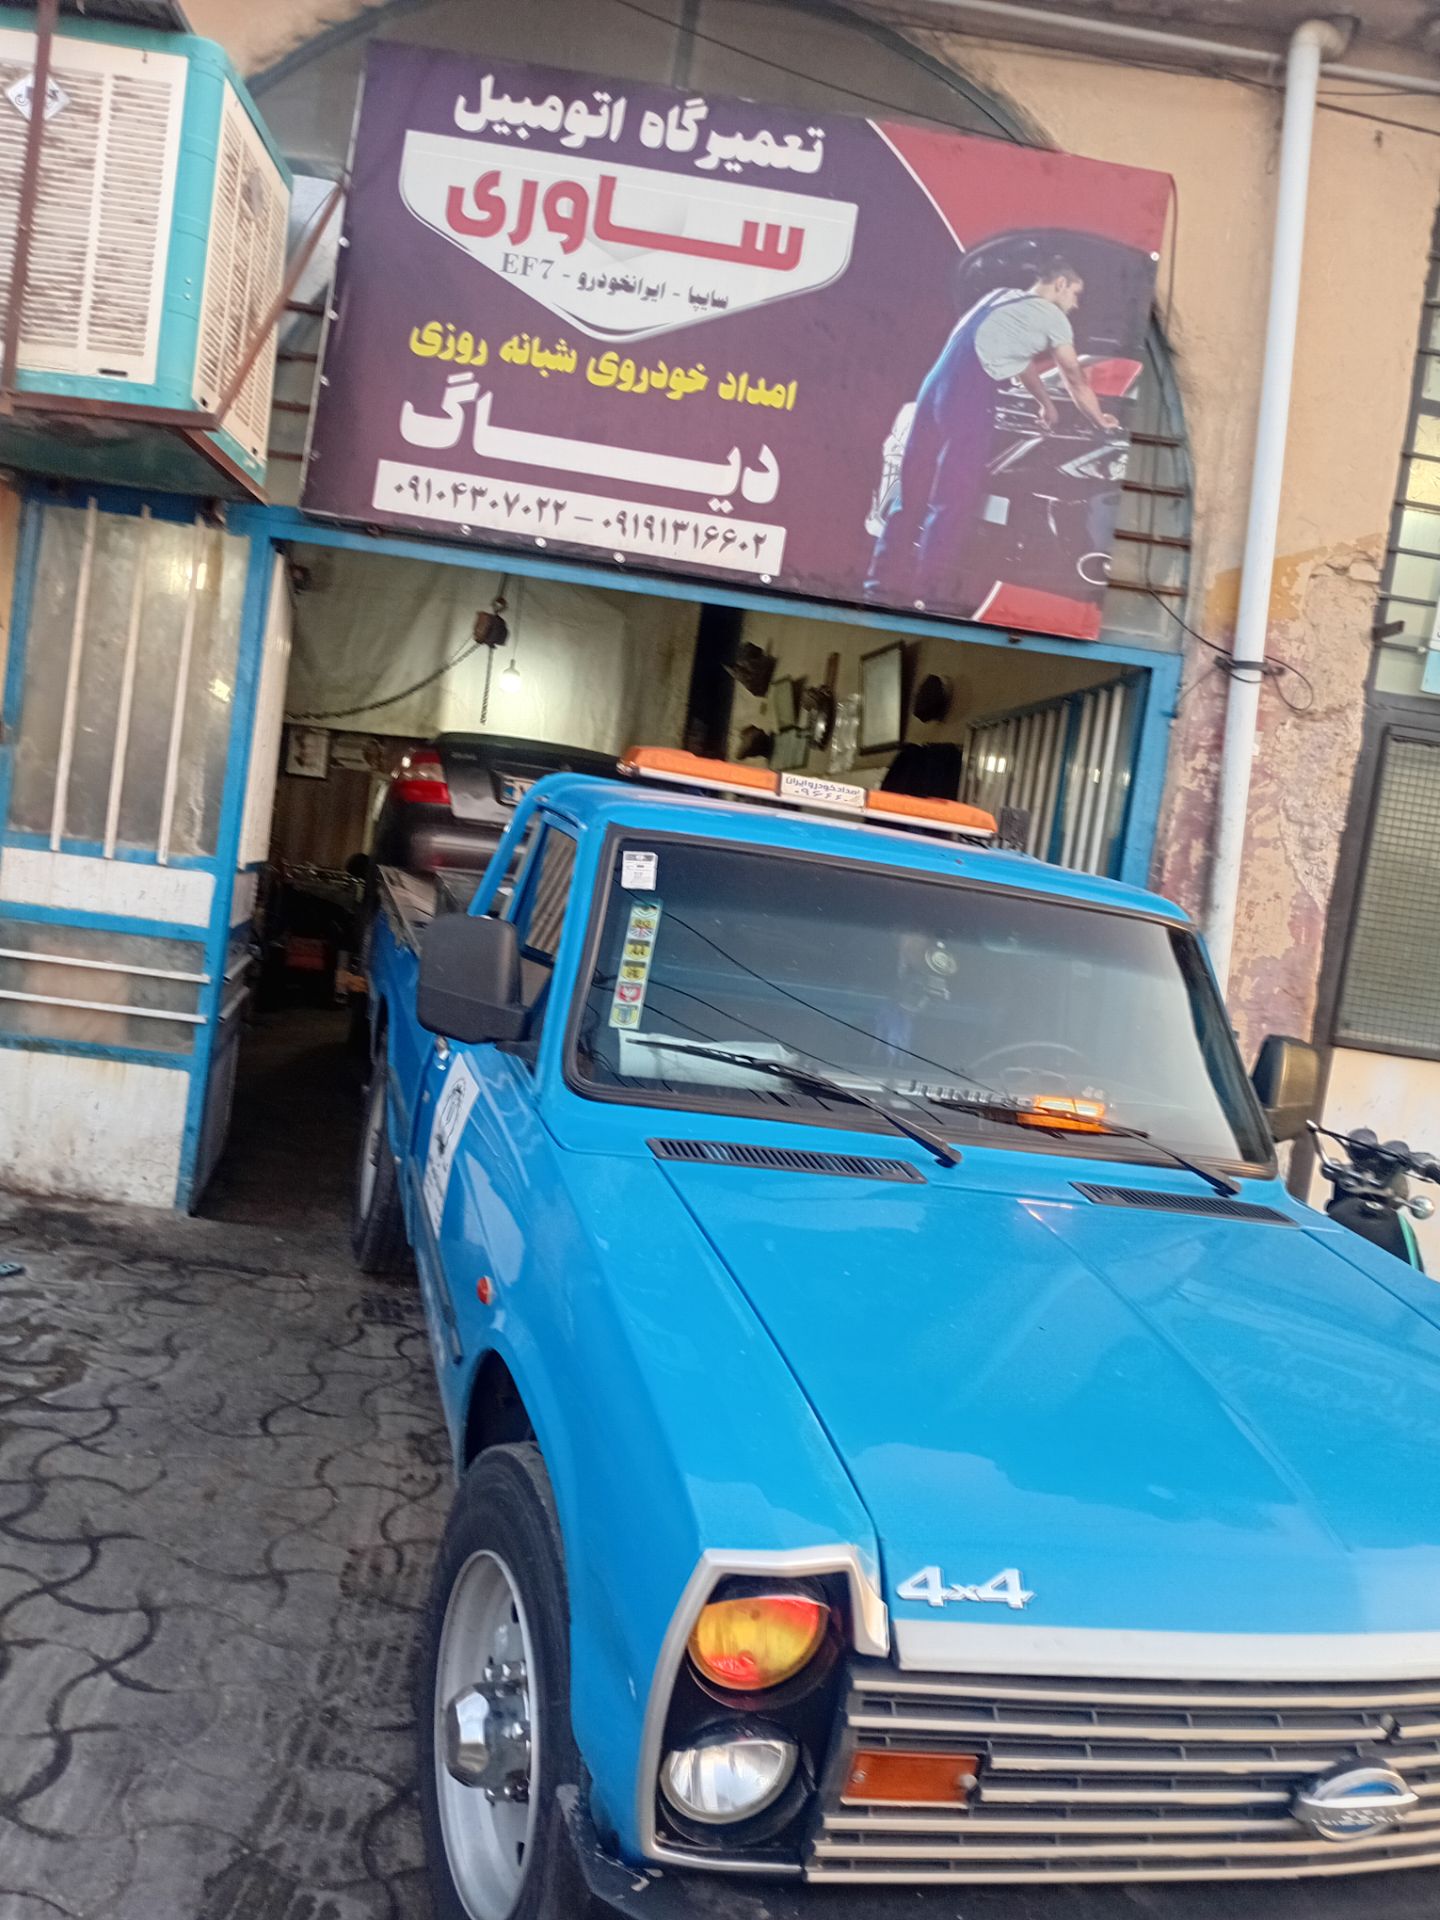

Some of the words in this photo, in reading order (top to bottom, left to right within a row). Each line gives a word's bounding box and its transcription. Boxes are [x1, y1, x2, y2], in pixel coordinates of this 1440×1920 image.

[454, 75, 627, 146] اتومبیل
[638, 98, 826, 174] تعمیرگاه
[445, 169, 805, 272] ساوری
[501, 251, 555, 282] EF7
[576, 268, 666, 302] ایرانخودرو
[687, 282, 730, 312] سایپا
[408, 319, 490, 366] روزی
[498, 333, 578, 379] شبانه
[586, 350, 710, 402] خودروی
[717, 370, 798, 411] امداد
[394, 474, 568, 526] ۰۹۱۰۴۳۰۷۰۲۲
[602, 510, 767, 560] ۰۹۱۹۱۳۱۶۶۰۲
[896, 1564, 1036, 1609] 4x4
